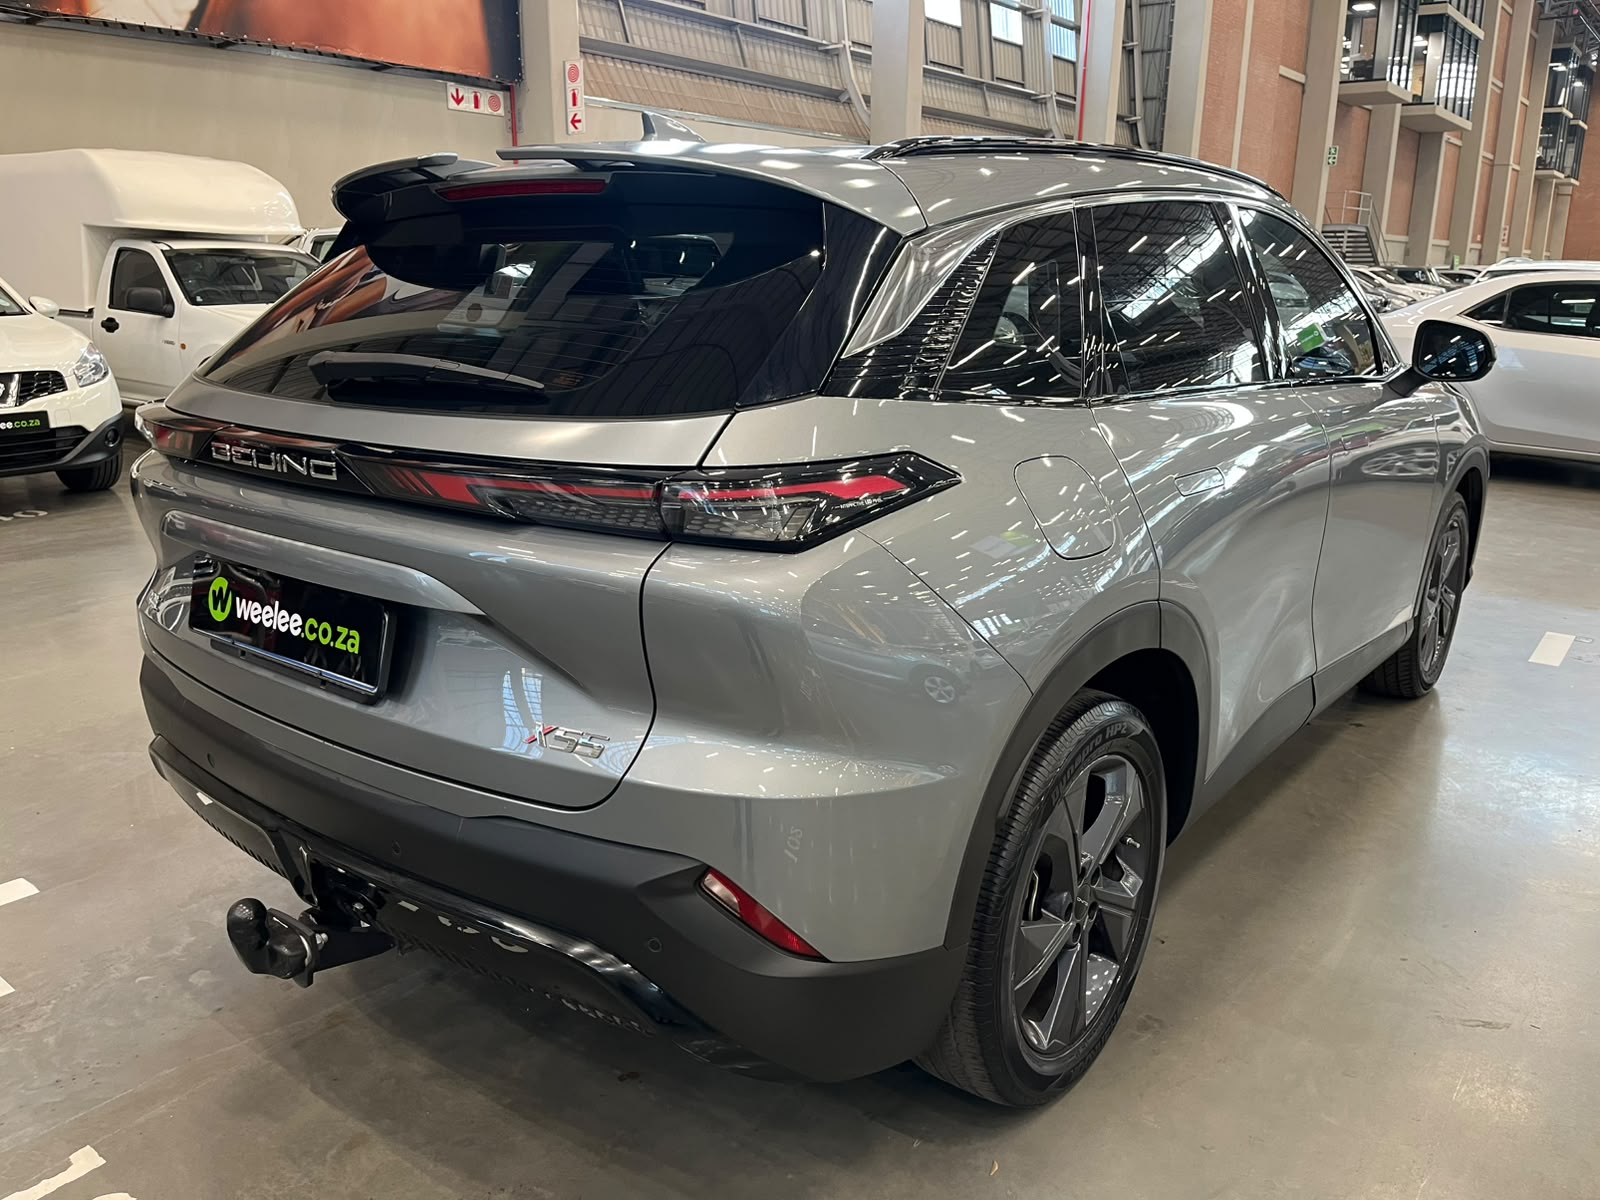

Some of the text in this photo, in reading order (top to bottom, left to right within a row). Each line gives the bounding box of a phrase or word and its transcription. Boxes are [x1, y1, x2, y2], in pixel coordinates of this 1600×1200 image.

[211, 441, 338, 481] BEIJING
[235, 596, 360, 655] weelee.co.za
[524, 721, 611, 759] X55
[1106, 722, 1128, 739] HP2
